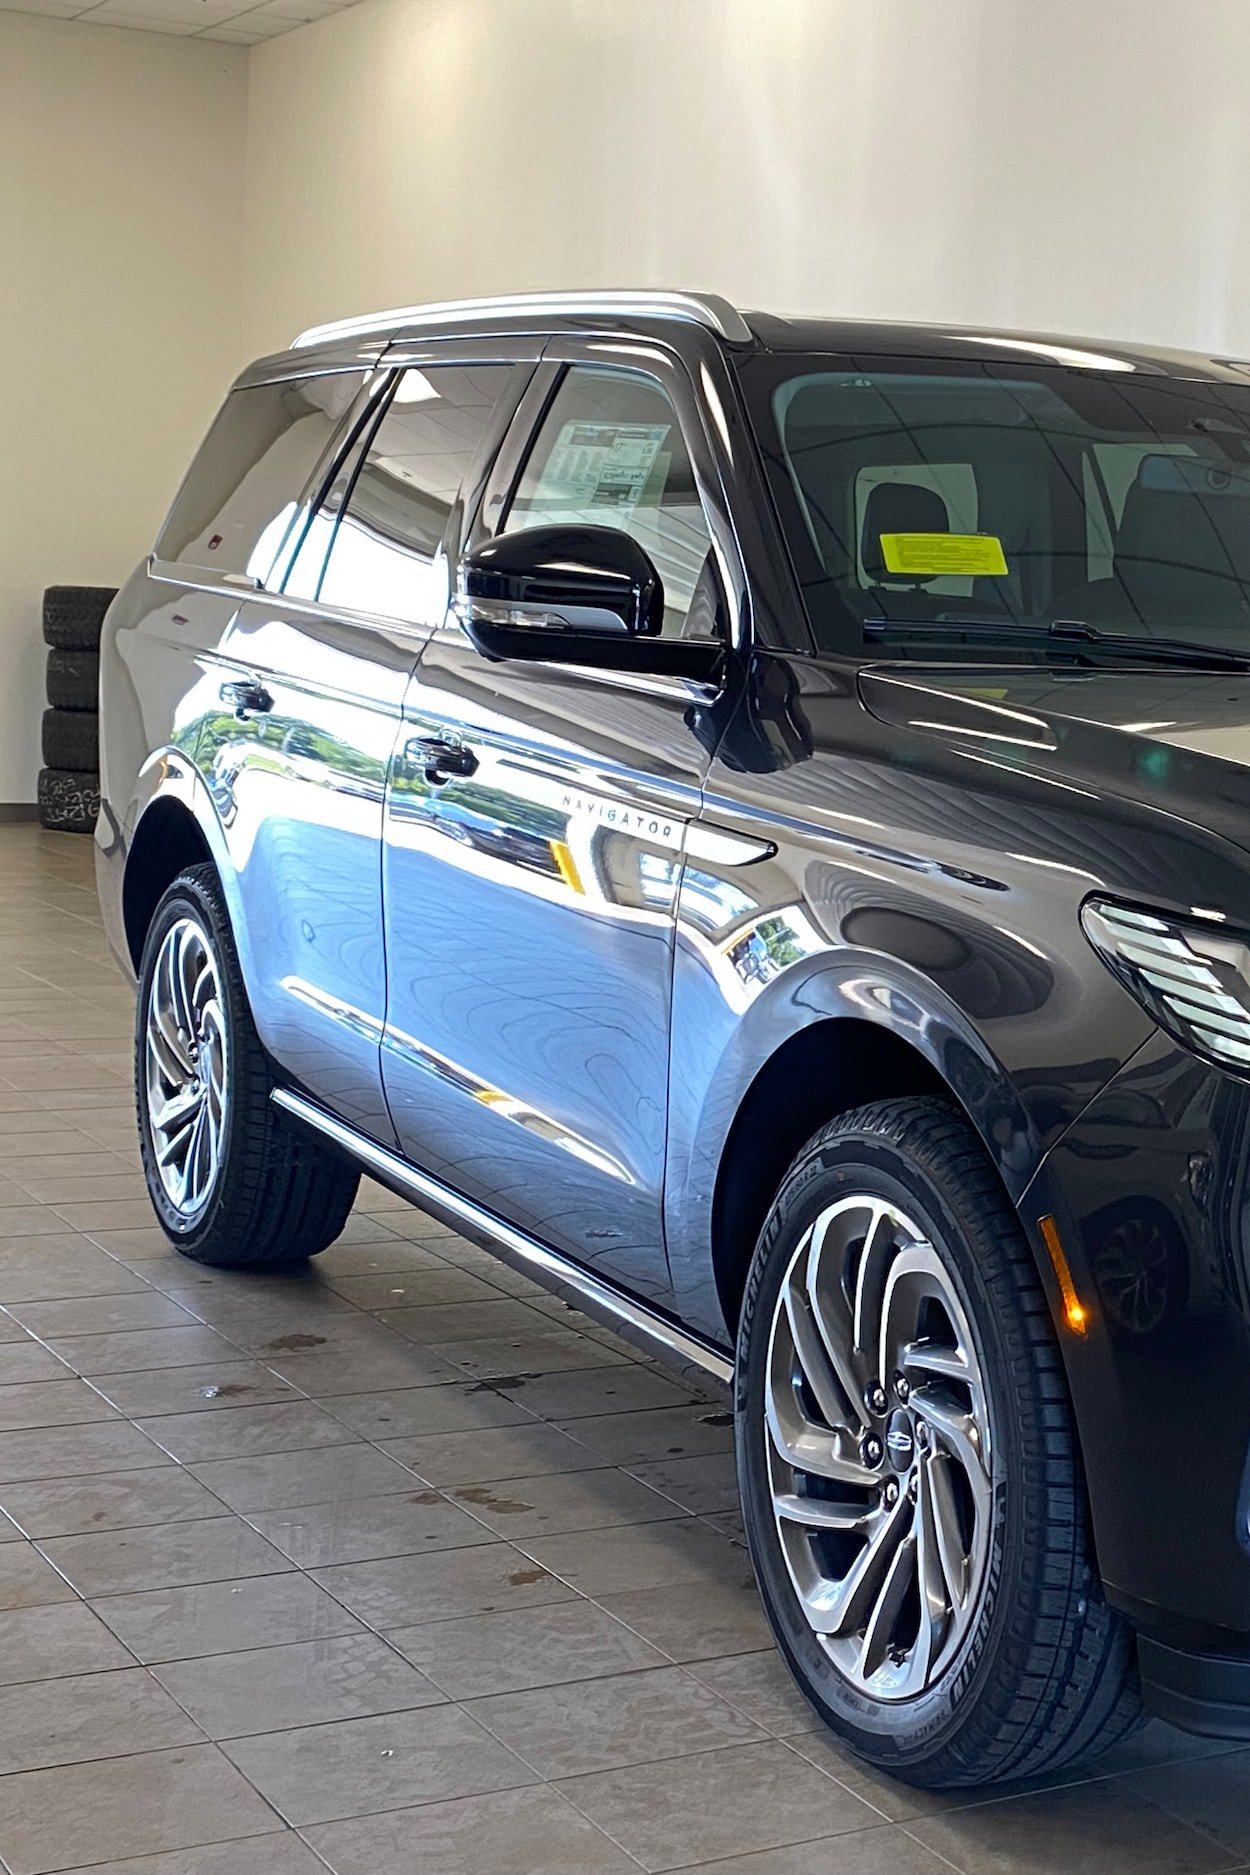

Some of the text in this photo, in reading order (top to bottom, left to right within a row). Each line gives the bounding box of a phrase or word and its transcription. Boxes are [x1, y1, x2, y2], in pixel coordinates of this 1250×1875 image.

[562, 795, 672, 838] NAVIGATOR
[739, 1205, 783, 1363] MICHELIN
[952, 1543, 1003, 1703] MICHELIN
